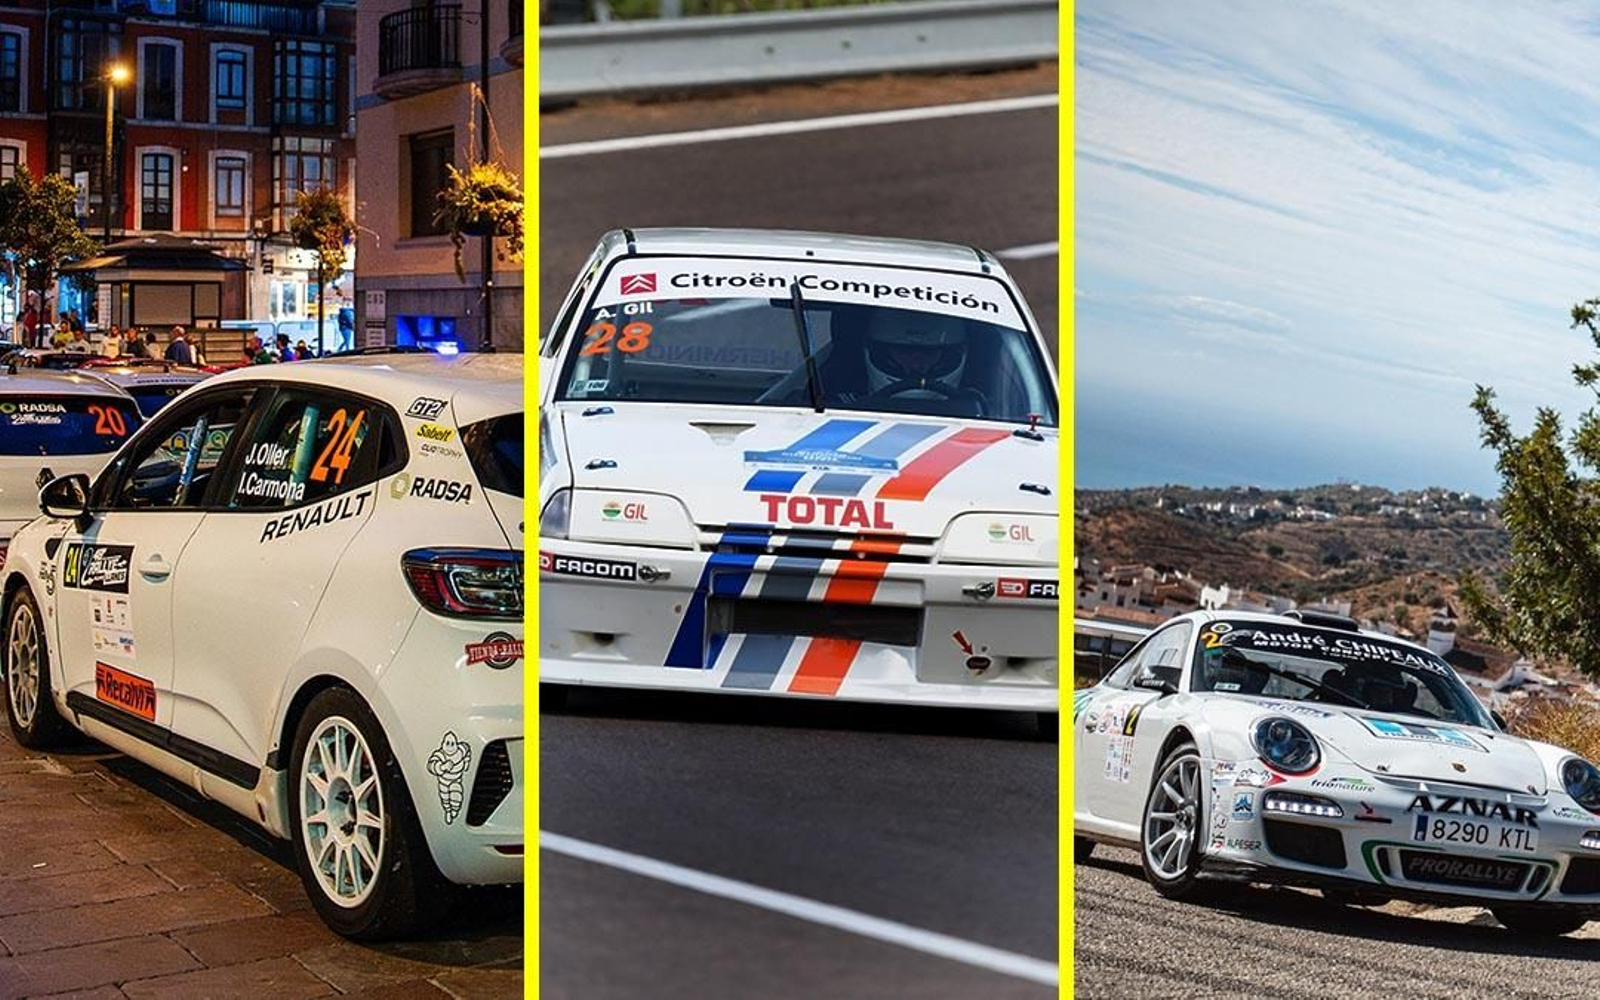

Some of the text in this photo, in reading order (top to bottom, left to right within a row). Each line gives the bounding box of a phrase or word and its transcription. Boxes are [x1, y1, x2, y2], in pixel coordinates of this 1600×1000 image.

[670, 273, 999, 313] Citroën Competición
[595, 309, 617, 320] A.
[579, 321, 653, 356] 28
[19, 403, 67, 413] RADSA
[88, 404, 126, 436] 20
[417, 423, 452, 442] Sabelt
[245, 442, 290, 466] J.Oller
[310, 408, 365, 484] 24
[237, 472, 306, 501] I.Carmona
[410, 477, 472, 503] RADSA
[260, 491, 371, 543] RENAULT
[624, 503, 648, 520] GIL
[760, 494, 894, 529] TOTAL
[1009, 525, 1035, 542] GIL
[65, 547, 79, 583] 24
[555, 559, 633, 577] FACOM
[1201, 631, 1219, 649] 2
[1253, 640, 1313, 650] MOTOR
[1252, 630, 1449, 677] André CHIPEAUX
[1125, 709, 1138, 734] 2
[1311, 778, 1376, 793] frionature
[1407, 794, 1540, 829] AZNAR
[1432, 819, 1535, 851] 8290 KTL
[1409, 856, 1518, 881] PRORALLYE
